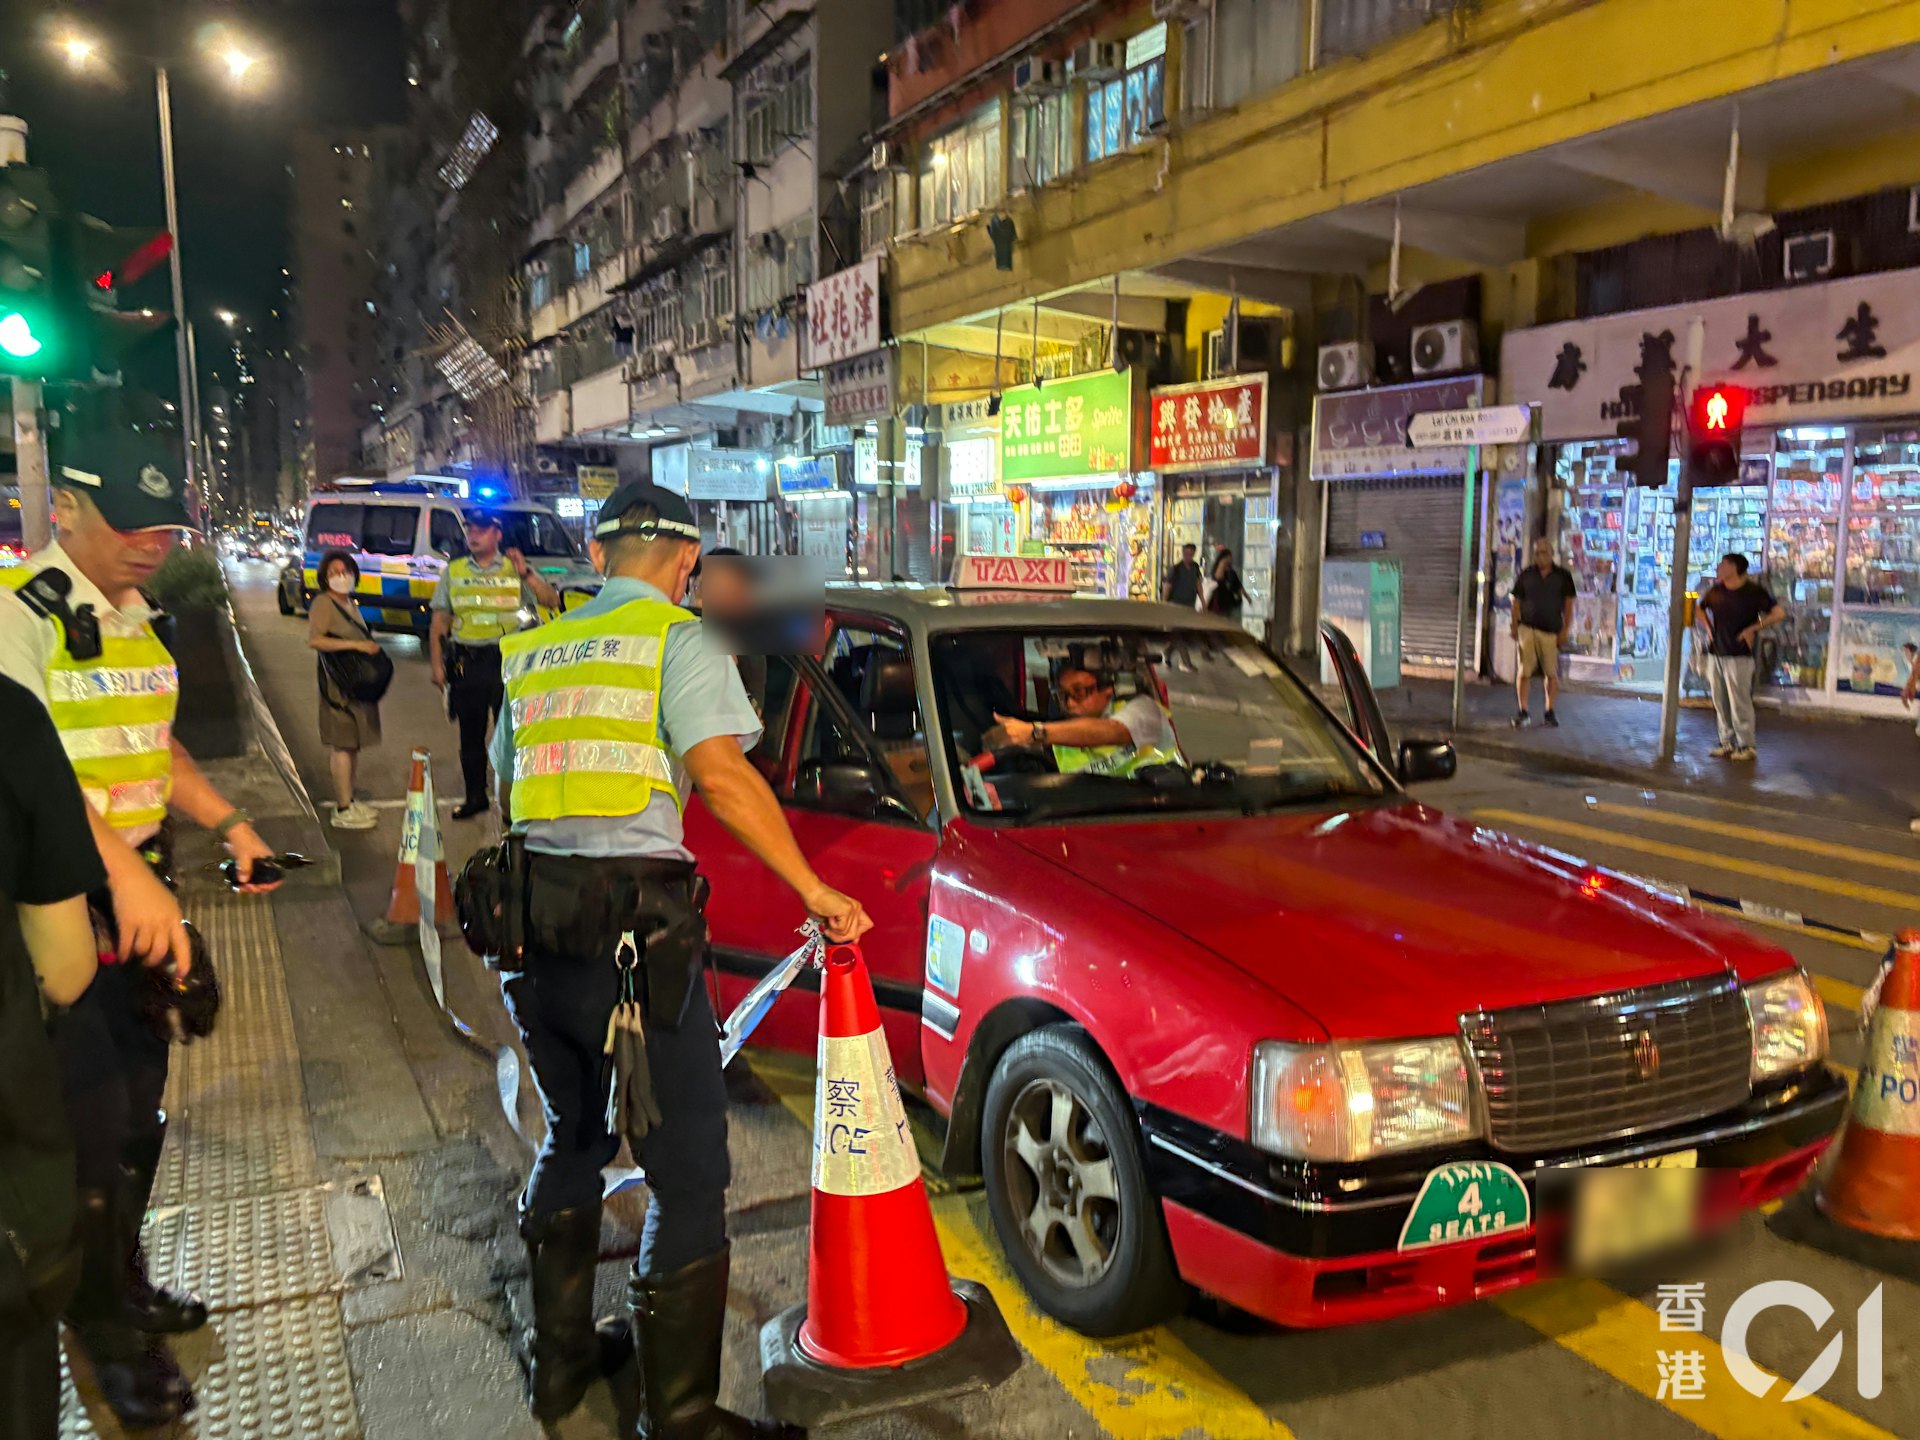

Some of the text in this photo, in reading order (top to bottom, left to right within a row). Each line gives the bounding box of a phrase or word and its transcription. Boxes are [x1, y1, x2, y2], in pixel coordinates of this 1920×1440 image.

[1005, 395, 1084, 439] 天佑士多
[971, 558, 1066, 583] TAXI
[541, 640, 597, 667] POLICE
[602, 640, 620, 658] 察
[826, 1077, 861, 1118] 察
[1440, 1162, 1493, 1188] TAXI
[1457, 1182, 1483, 1217] 4
[1429, 1210, 1506, 1244] SEATS
